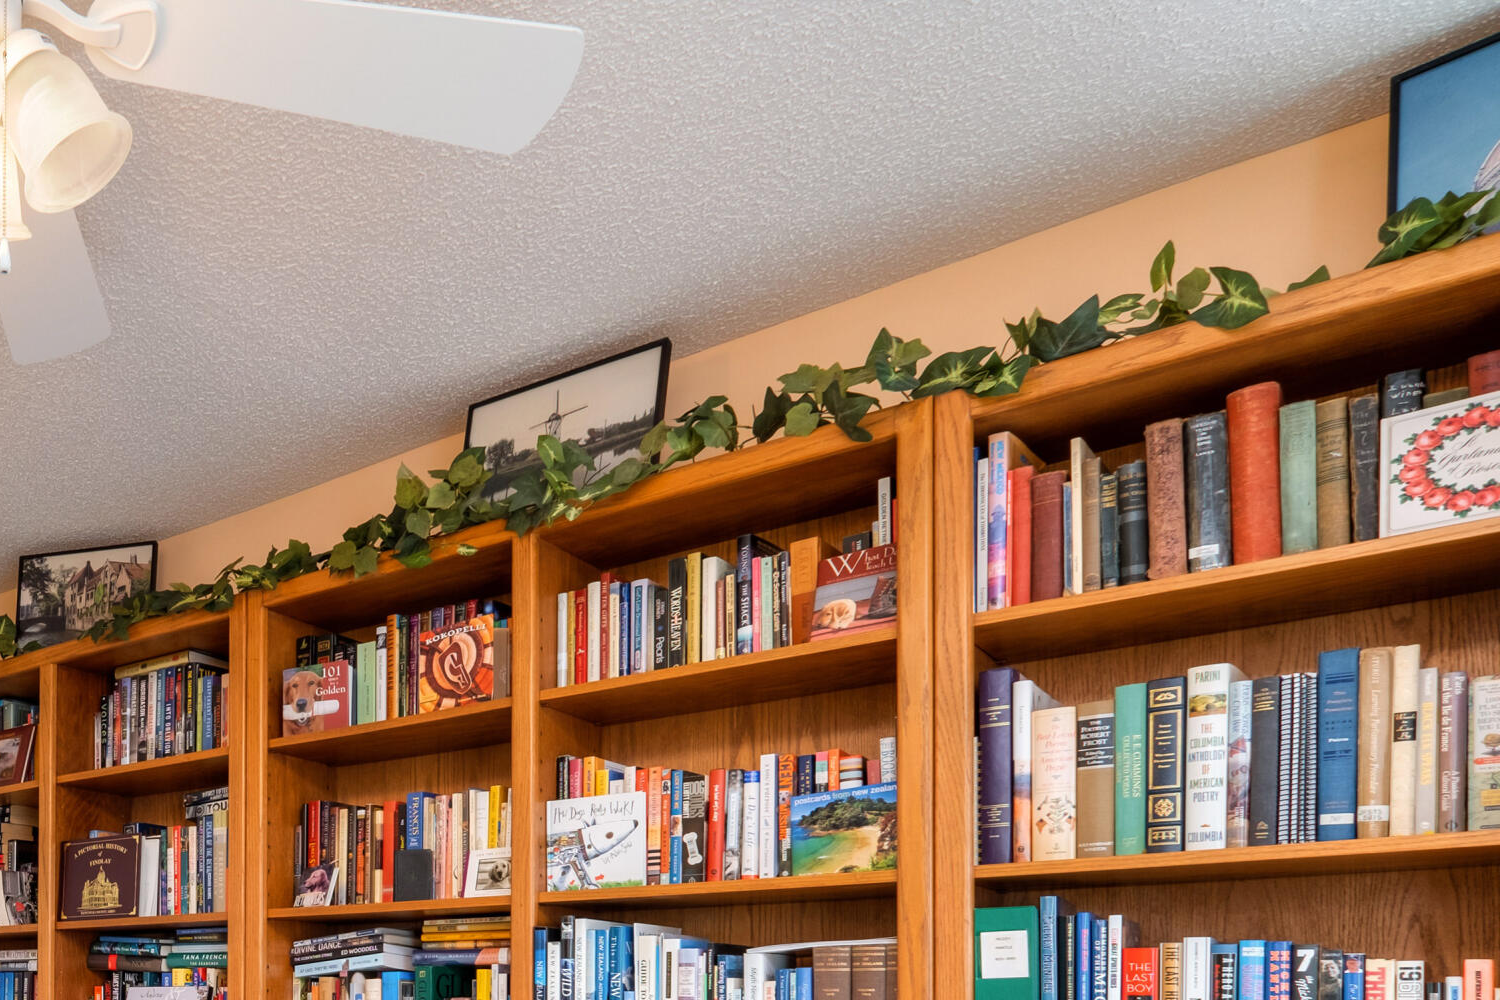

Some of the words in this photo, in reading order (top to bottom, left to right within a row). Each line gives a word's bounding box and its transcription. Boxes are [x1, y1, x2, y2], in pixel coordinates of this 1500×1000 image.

[741, 597, 749, 626] SHACK
[426, 624, 486, 645] KOKOPELLI
[656, 637, 664, 663] Pearls
[322, 665, 341, 678] 101
[1196, 671, 1220, 682] PARINI
[316, 686, 346, 697] Golden
[1201, 724, 1212, 733] THE
[1190, 736, 1225, 749] COLUMBIA
[1188, 751, 1225, 762] ANTHOLOGY
[779, 754, 794, 791] SCENT
[1190, 777, 1223, 789] AMERICAN
[795, 794, 831, 806] postcards
[1193, 792, 1219, 802] POETRY
[1188, 831, 1222, 842] COLUMBIA
[295, 944, 316, 954] DIVINE
[319, 942, 341, 950] DANCE
[1165, 946, 1179, 961] THE
[1297, 949, 1315, 972] 7
[1129, 963, 1151, 971] THE
[562, 968, 571, 996] WILD
[1126, 973, 1154, 982] LAST
[1165, 966, 1179, 987] LAST
[1221, 965, 1233, 990] HERO
[610, 973, 620, 999] NEW
[1127, 984, 1153, 993] BOY
